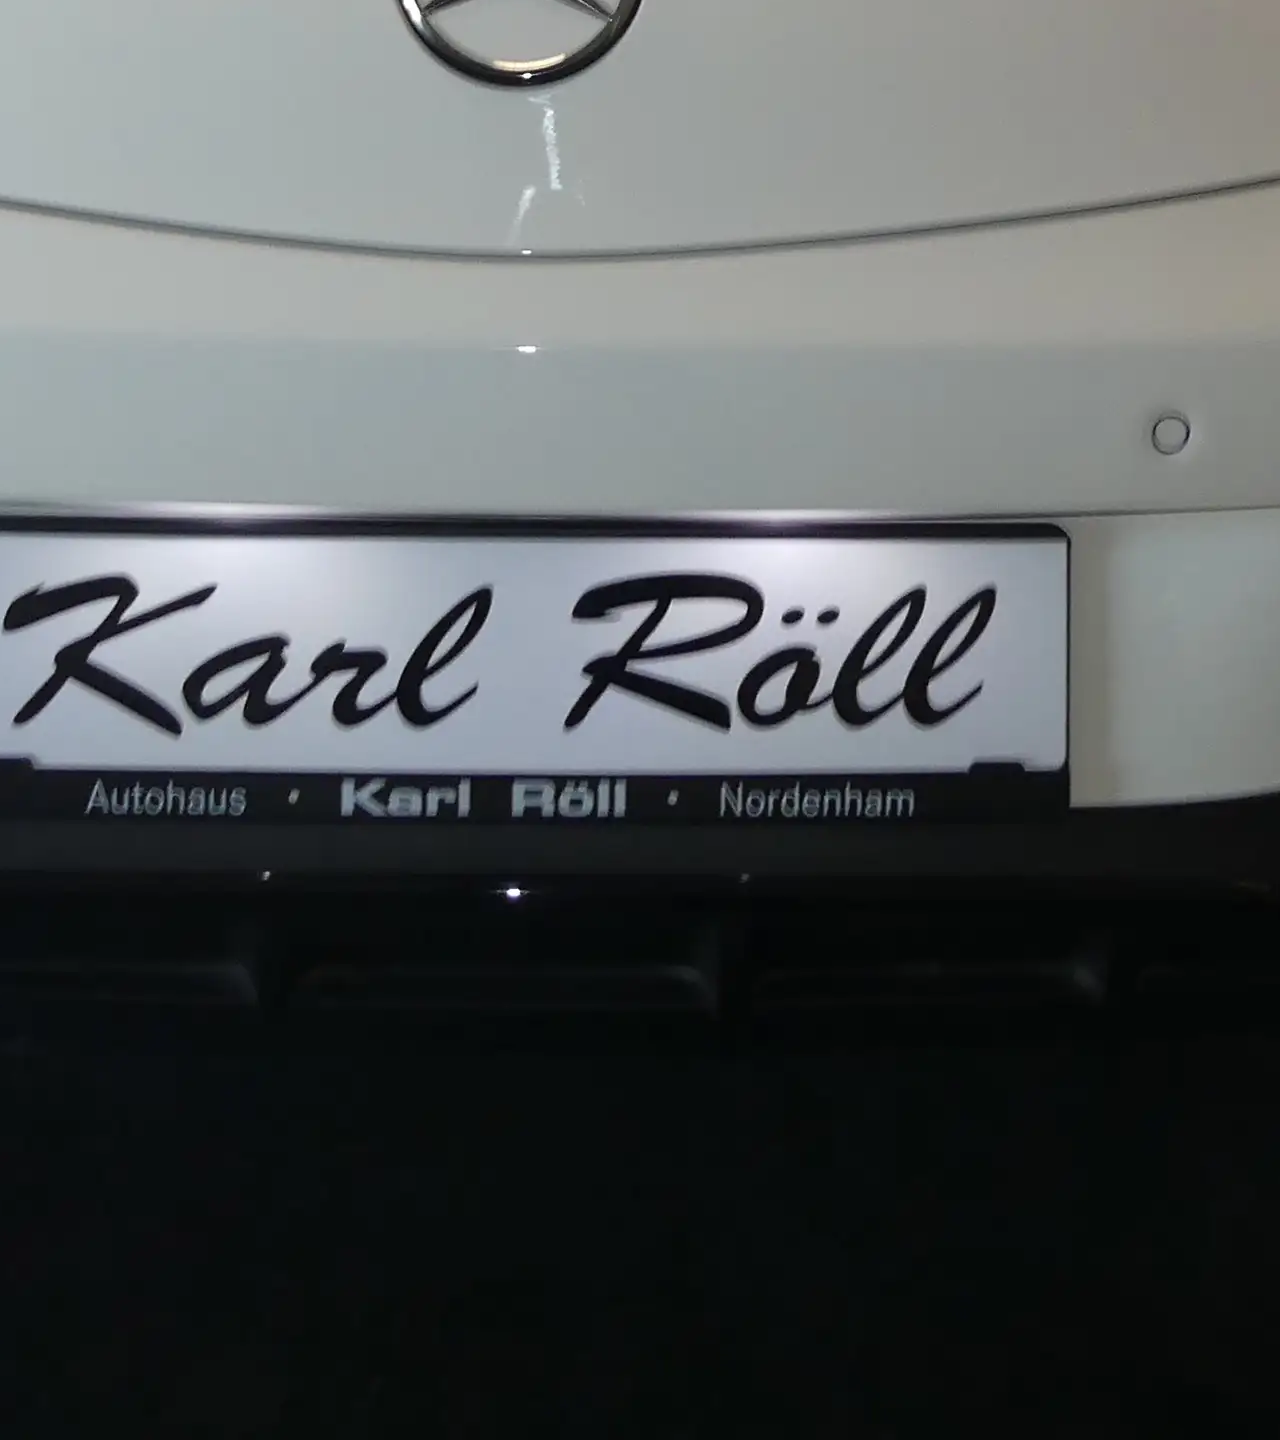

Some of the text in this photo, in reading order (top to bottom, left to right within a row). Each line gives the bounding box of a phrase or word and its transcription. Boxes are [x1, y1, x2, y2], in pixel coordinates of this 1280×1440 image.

[1, 572, 998, 738] Karl Röll
[84, 778, 916, 818] Autohaus Karl Röll Nordenham
